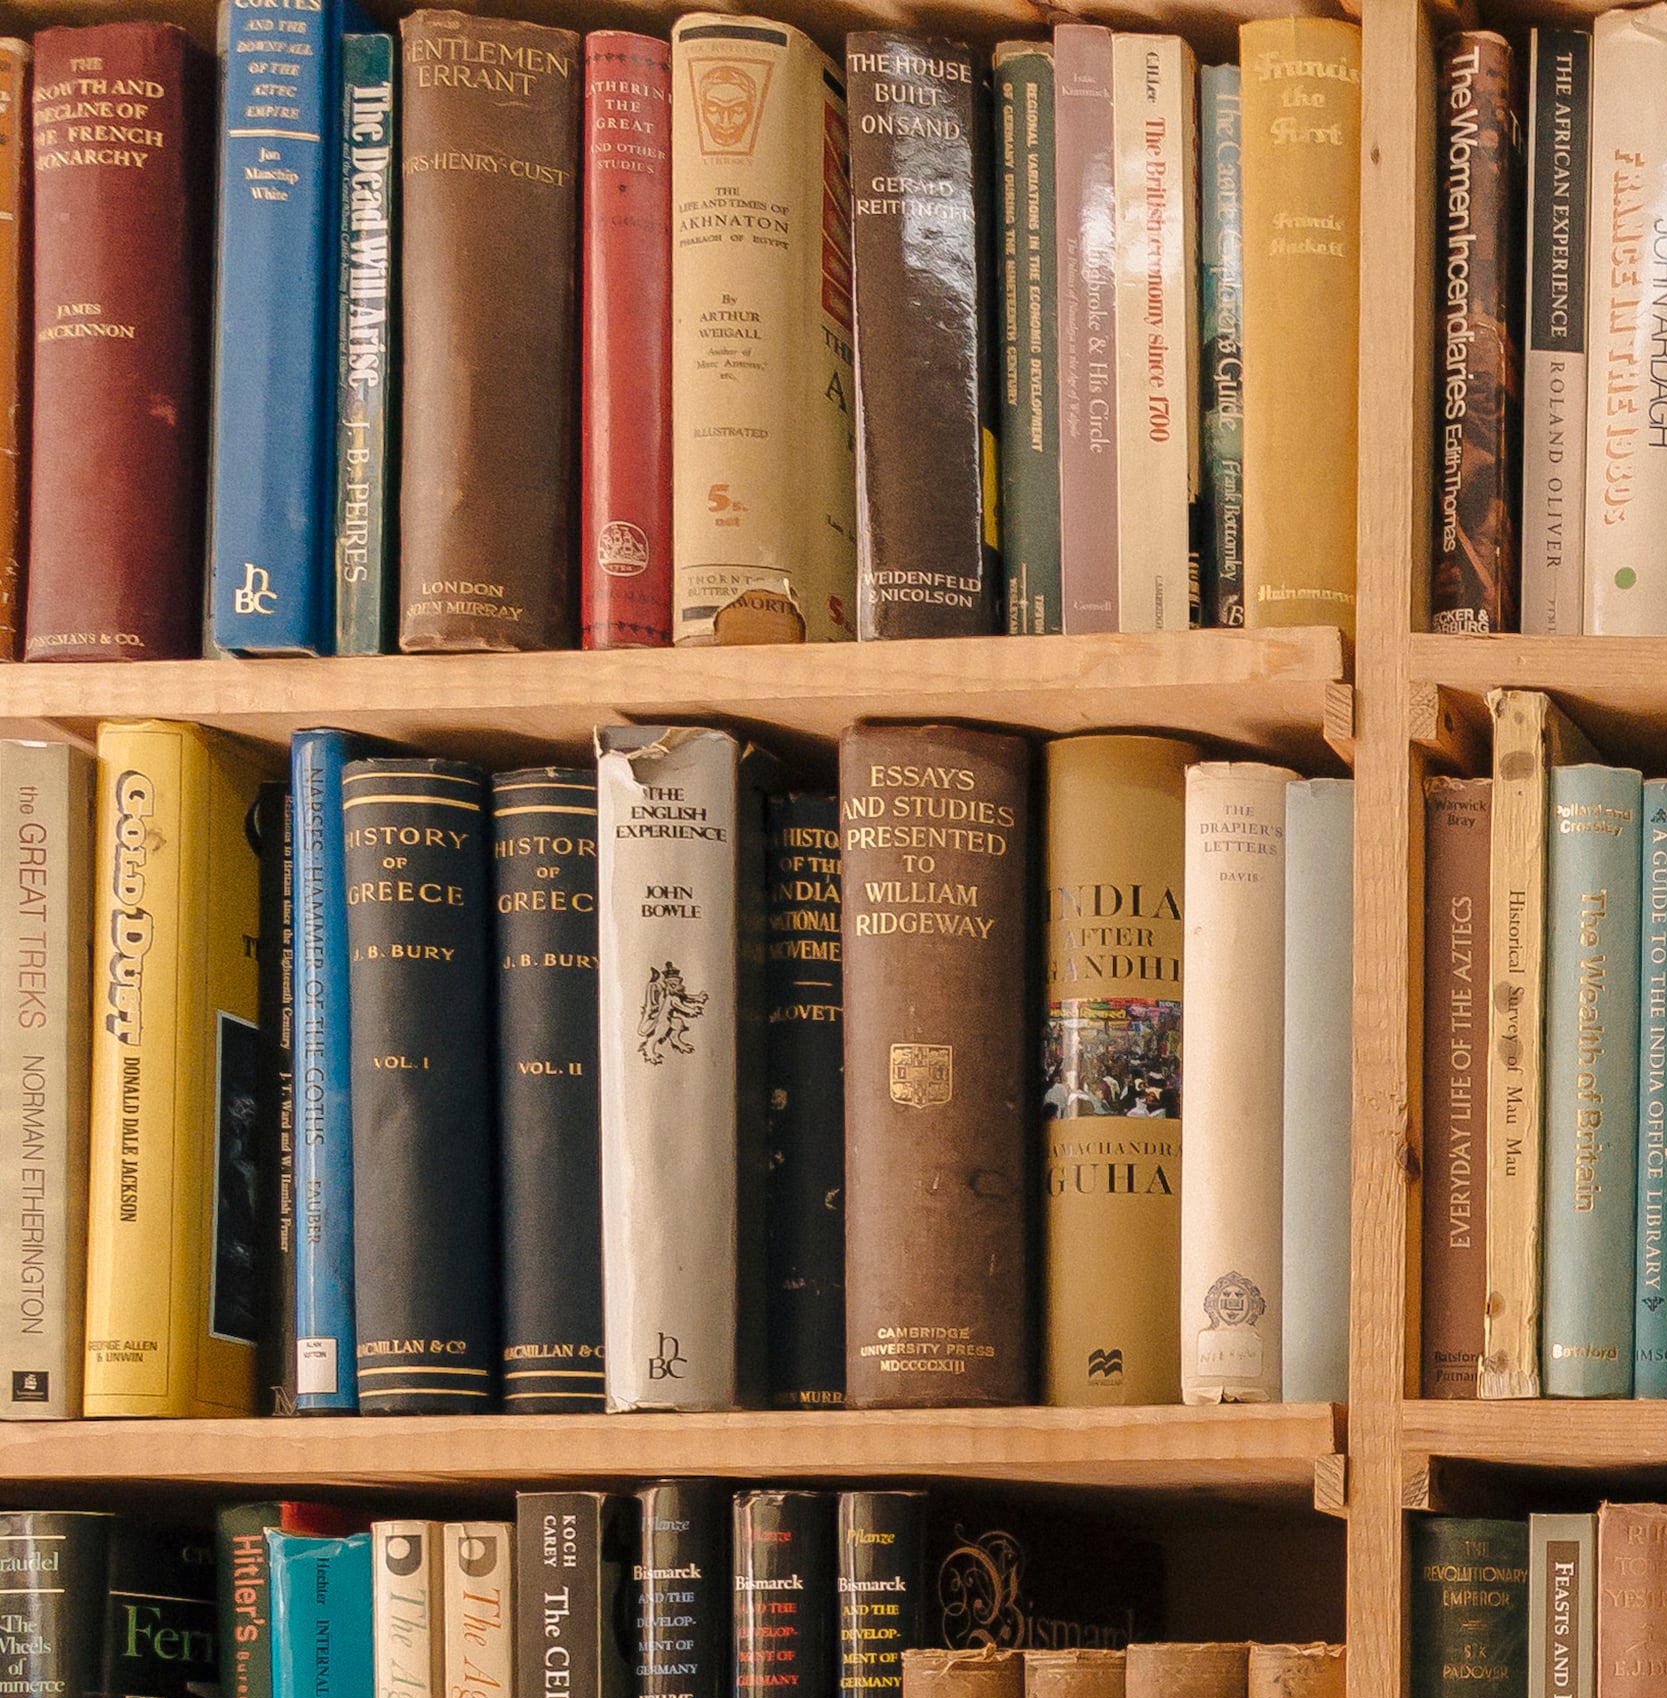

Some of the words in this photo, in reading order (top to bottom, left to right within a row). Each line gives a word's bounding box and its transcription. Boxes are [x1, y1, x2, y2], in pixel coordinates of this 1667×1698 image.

[1450, 46, 1479, 100] The
[352, 82, 392, 142] The
[350, 145, 389, 235] Dead
[1447, 105, 1472, 231] Women
[349, 234, 386, 298] Will
[348, 302, 387, 387] Arise
[1445, 232, 1473, 419] Incendiaries
[1548, 361, 1564, 462] ROLAND
[1546, 477, 1562, 568] OLIVER
[422, 582, 504, 597] LONDON
[863, 572, 980, 592] WEIDENFELD
[871, 765, 976, 790] ESSAYS
[843, 799, 885, 821] AND
[893, 797, 1014, 827] STUDIES
[846, 827, 1007, 856] PRESENTED
[903, 855, 934, 873] TO
[865, 882, 978, 907] WILLIAM
[855, 914, 995, 938] RIDGEWAY
[123, 1057, 140, 1116] DONALD
[519, 1062, 562, 1076] VOL.
[569, 1062, 582, 1075] II
[21, 1055, 47, 1159] NORMAN
[121, 1119, 138, 1156] DALE
[120, 1159, 138, 1222] JACKSON
[21, 1168, 46, 1334] ETHERINGTON
[543, 1515, 557, 1568] CAREY
[561, 1515, 576, 1568] KOCH
[544, 1592, 570, 1640] The
